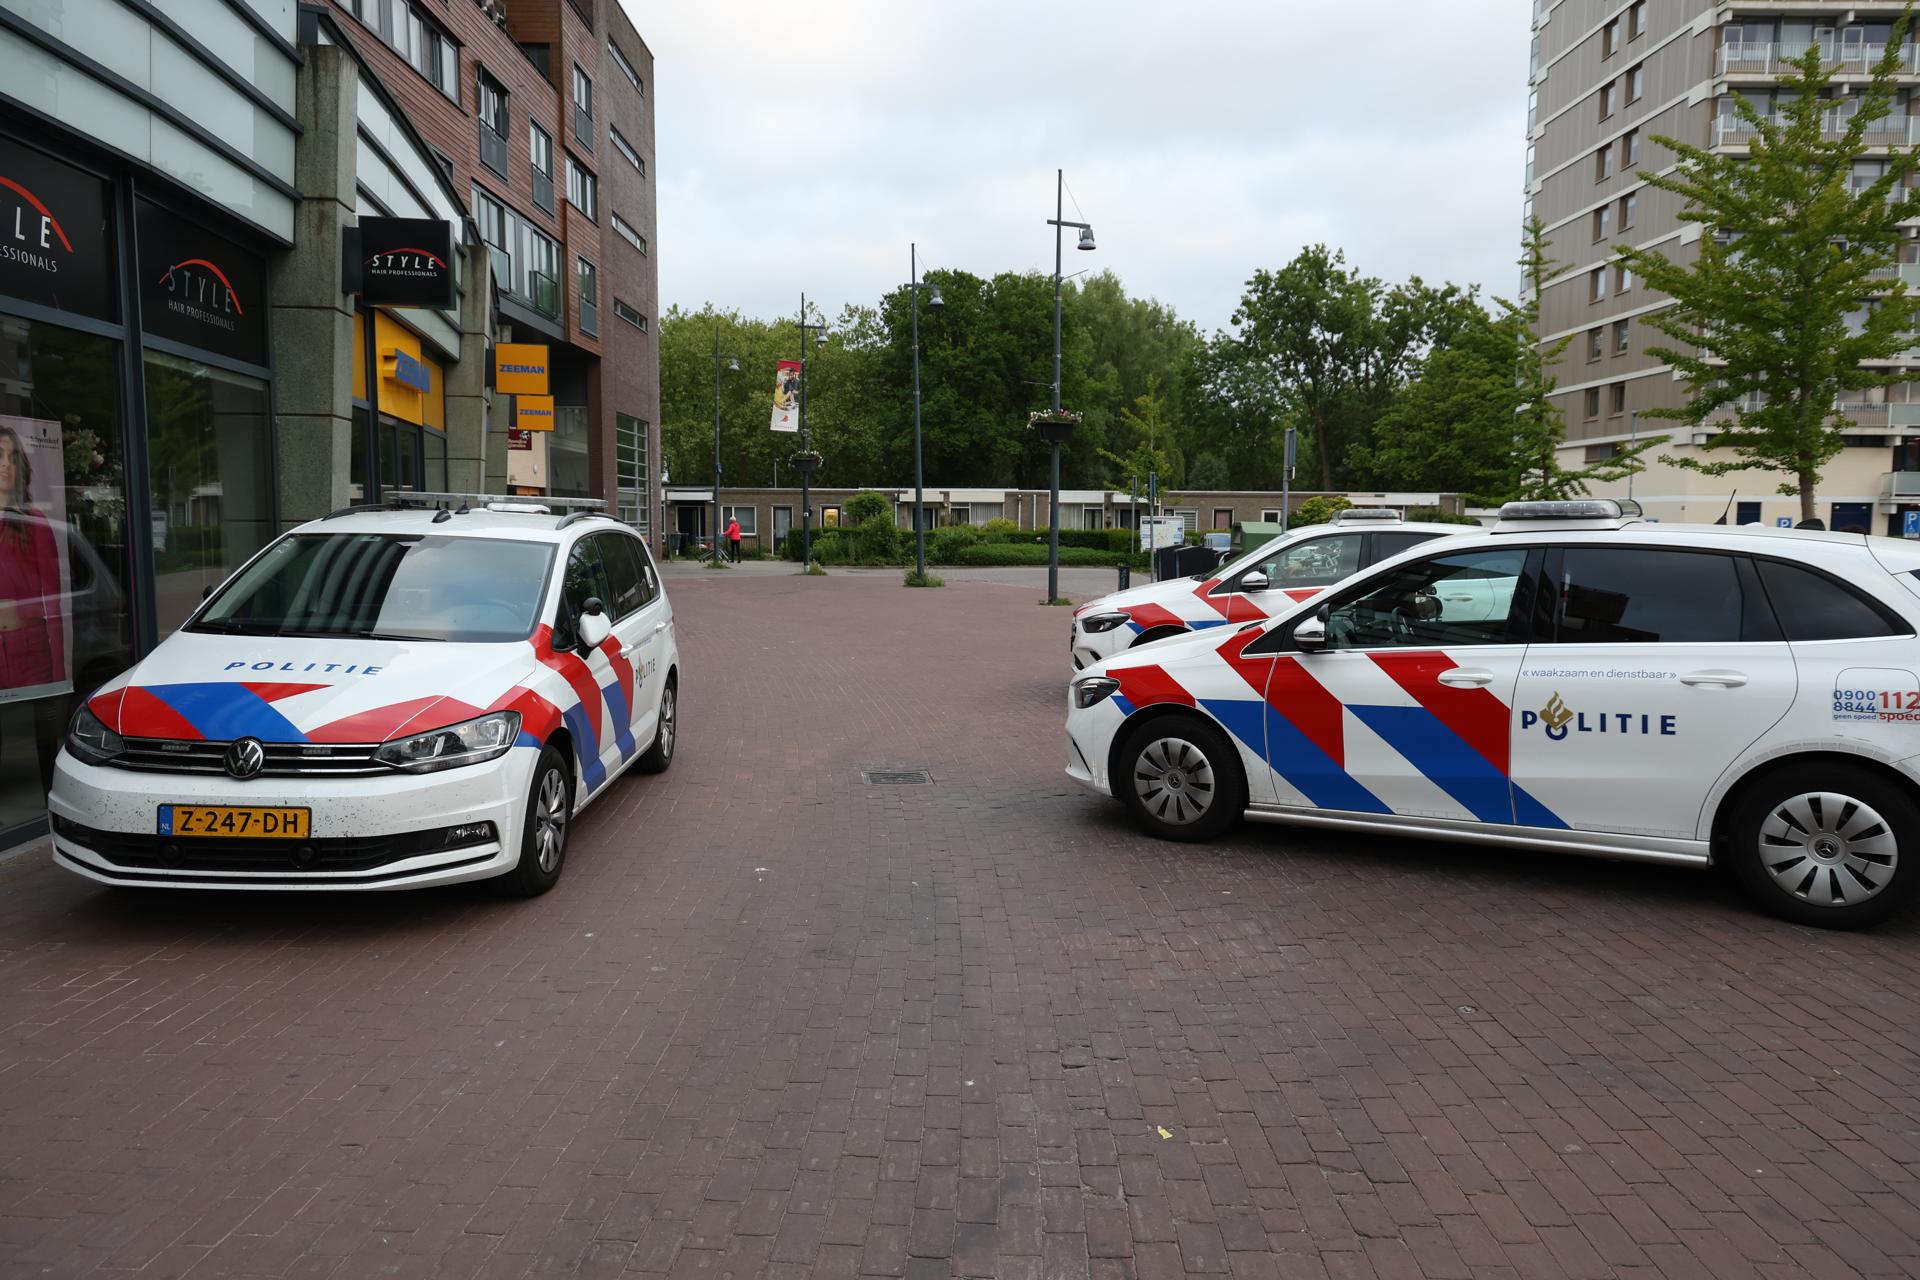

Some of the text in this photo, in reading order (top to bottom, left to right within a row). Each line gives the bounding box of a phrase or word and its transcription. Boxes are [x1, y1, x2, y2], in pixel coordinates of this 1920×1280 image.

[372, 254, 436, 270] STYLE
[168, 265, 231, 312] STYLE
[168, 299, 236, 331] HAIR PROFESSIONALS
[499, 364, 545, 374] ZEEMAN
[1780, 519, 1790, 528] P
[1908, 513, 1918, 525] P
[224, 661, 384, 676] POLITIE
[1530, 668, 1589, 678] waakzaam
[1590, 670, 1605, 678] en
[1606, 668, 1668, 679] dienstbaar
[1833, 690, 1876, 701] 0900
[1879, 691, 1920, 710] 112
[1833, 701, 1876, 713] 8844
[1521, 710, 1677, 741] POLITIE
[161, 823, 171, 831] NL
[180, 810, 299, 834] Z-247-DH
